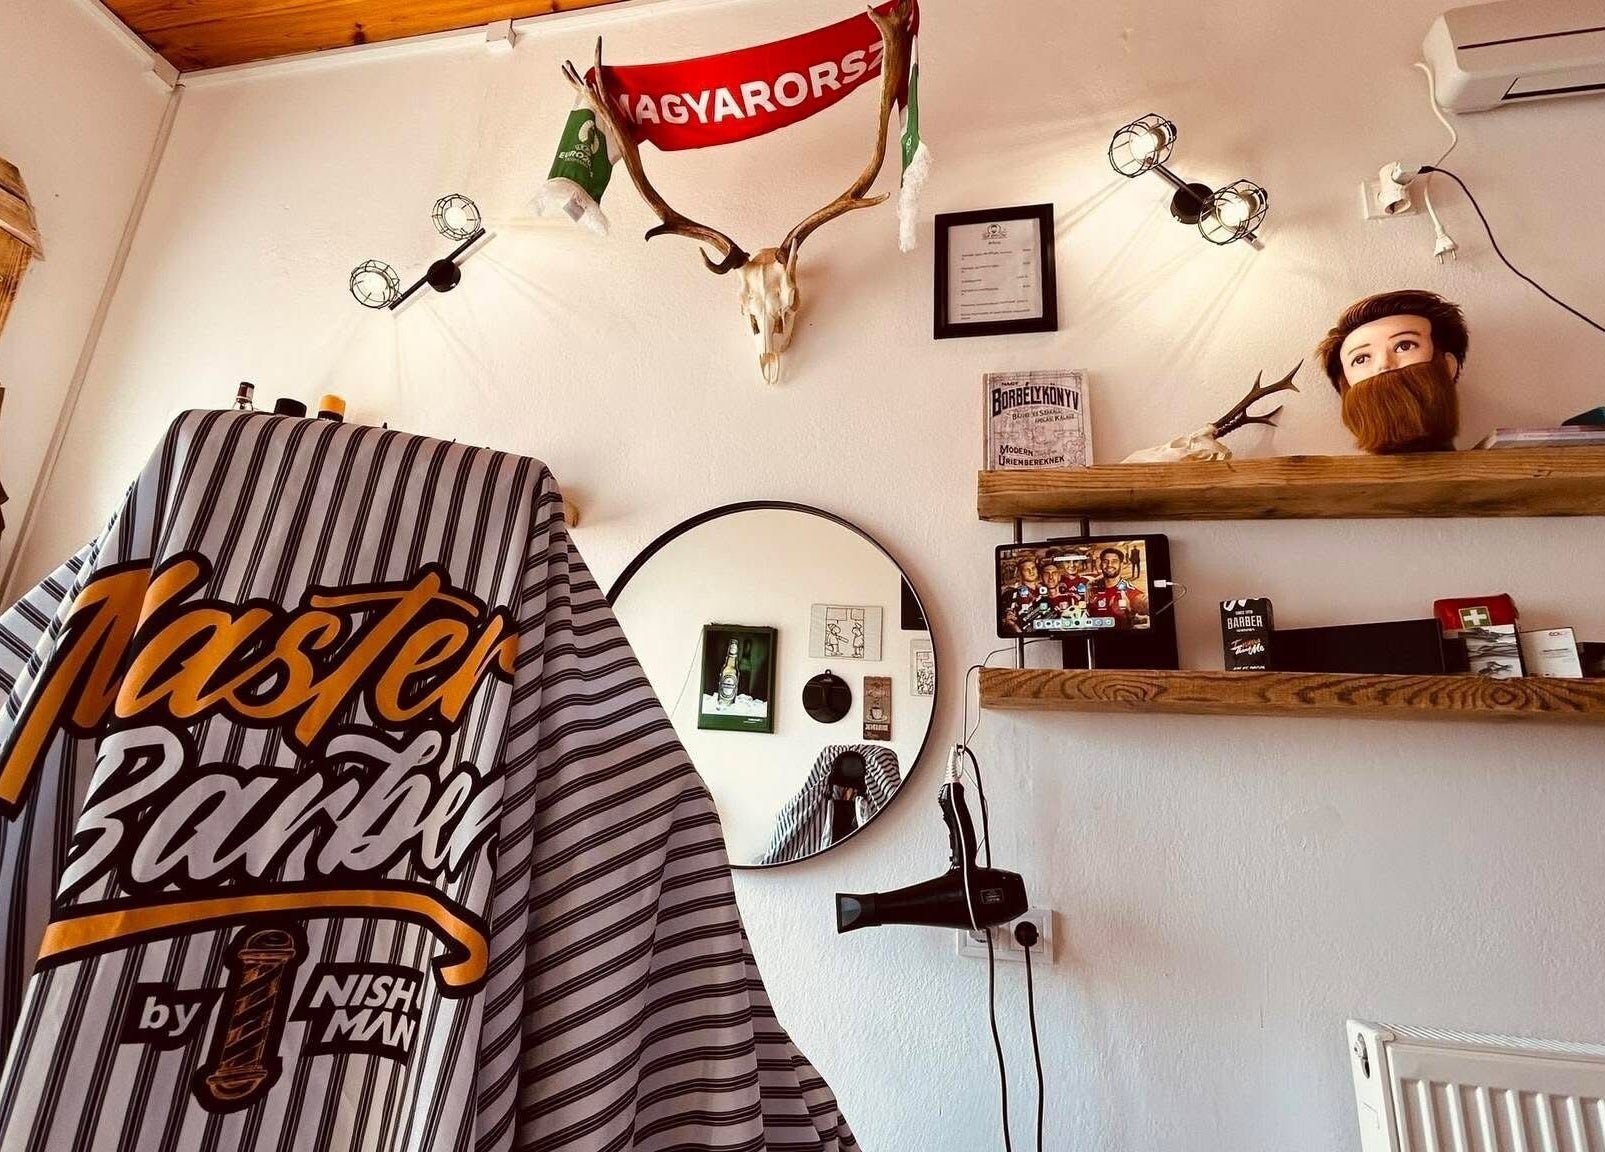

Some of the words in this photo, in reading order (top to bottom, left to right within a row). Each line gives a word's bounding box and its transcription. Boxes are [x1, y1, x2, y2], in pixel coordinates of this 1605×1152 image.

[992, 381, 1079, 418] BORBÉLYKÖNYV
[1227, 615, 1263, 630] BARBER
[56, 725, 505, 901] Barber
[309, 974, 417, 1013] NISH
[138, 996, 202, 1036] by
[321, 1008, 417, 1053] MAN
